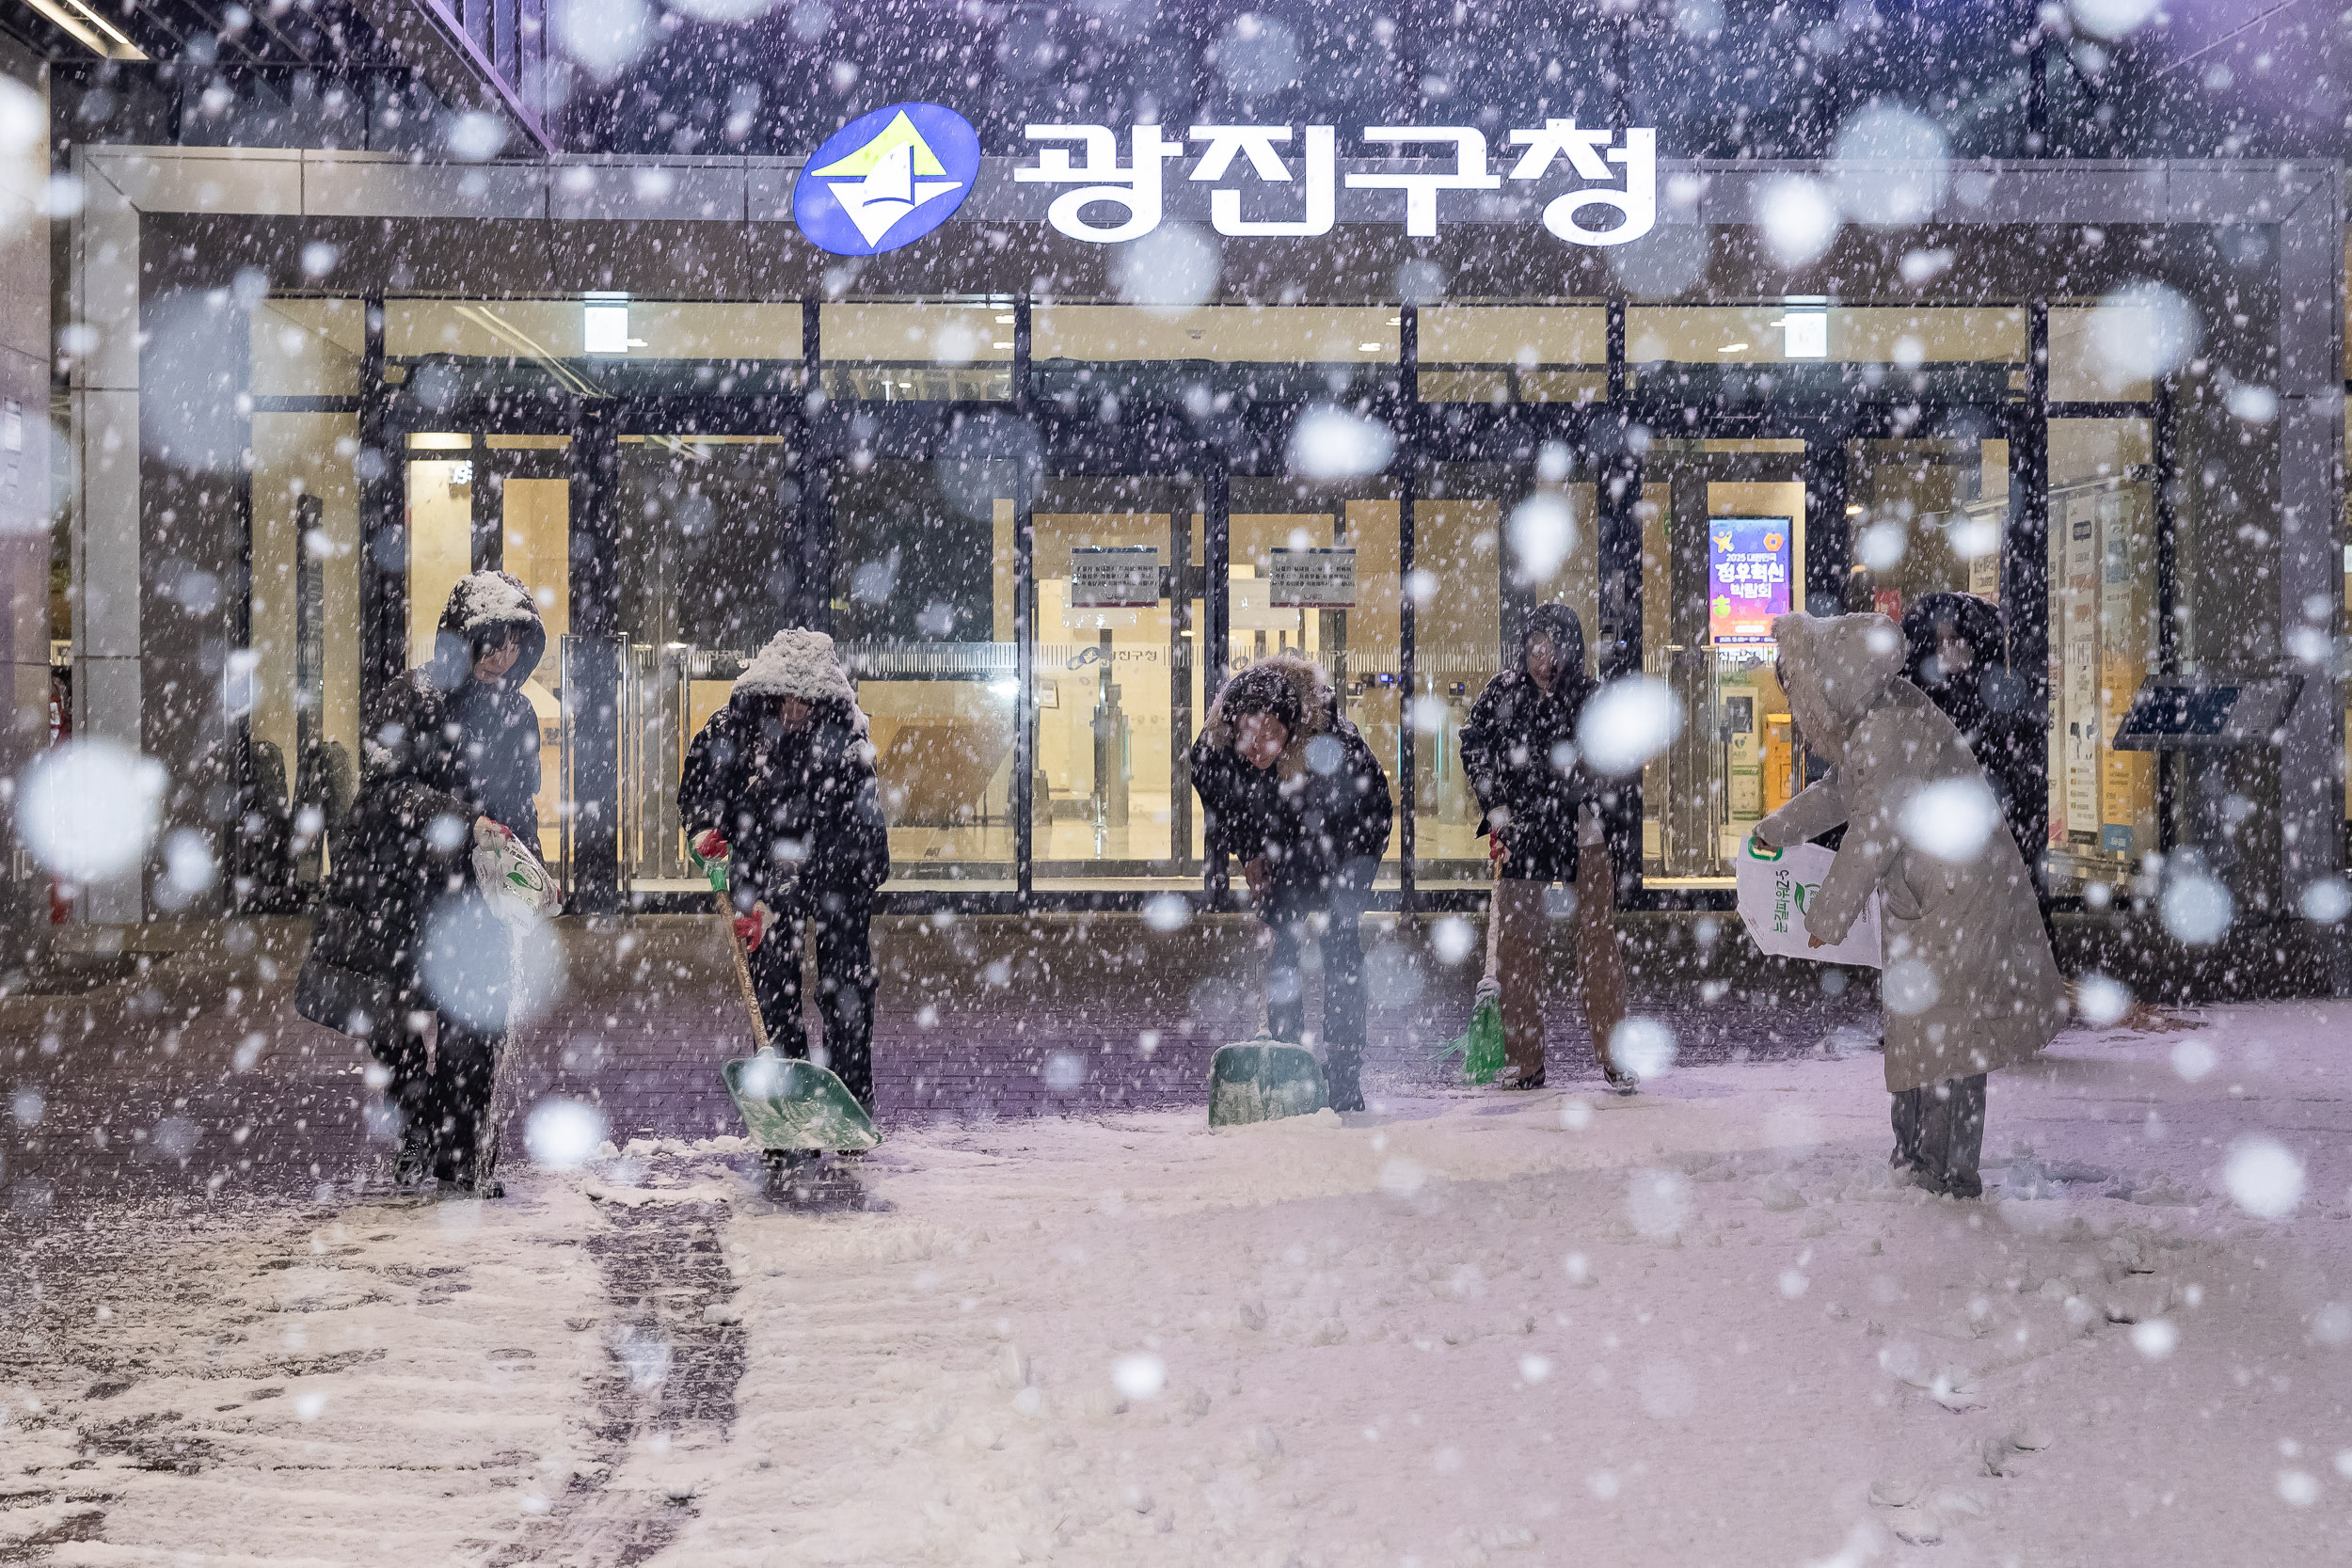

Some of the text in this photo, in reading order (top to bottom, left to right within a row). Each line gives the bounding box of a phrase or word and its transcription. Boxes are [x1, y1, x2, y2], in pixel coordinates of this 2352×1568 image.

[1014, 118, 1656, 246] 광진구청
[1725, 553, 1746, 562] 2025
[1730, 582, 1772, 599] 박람회
